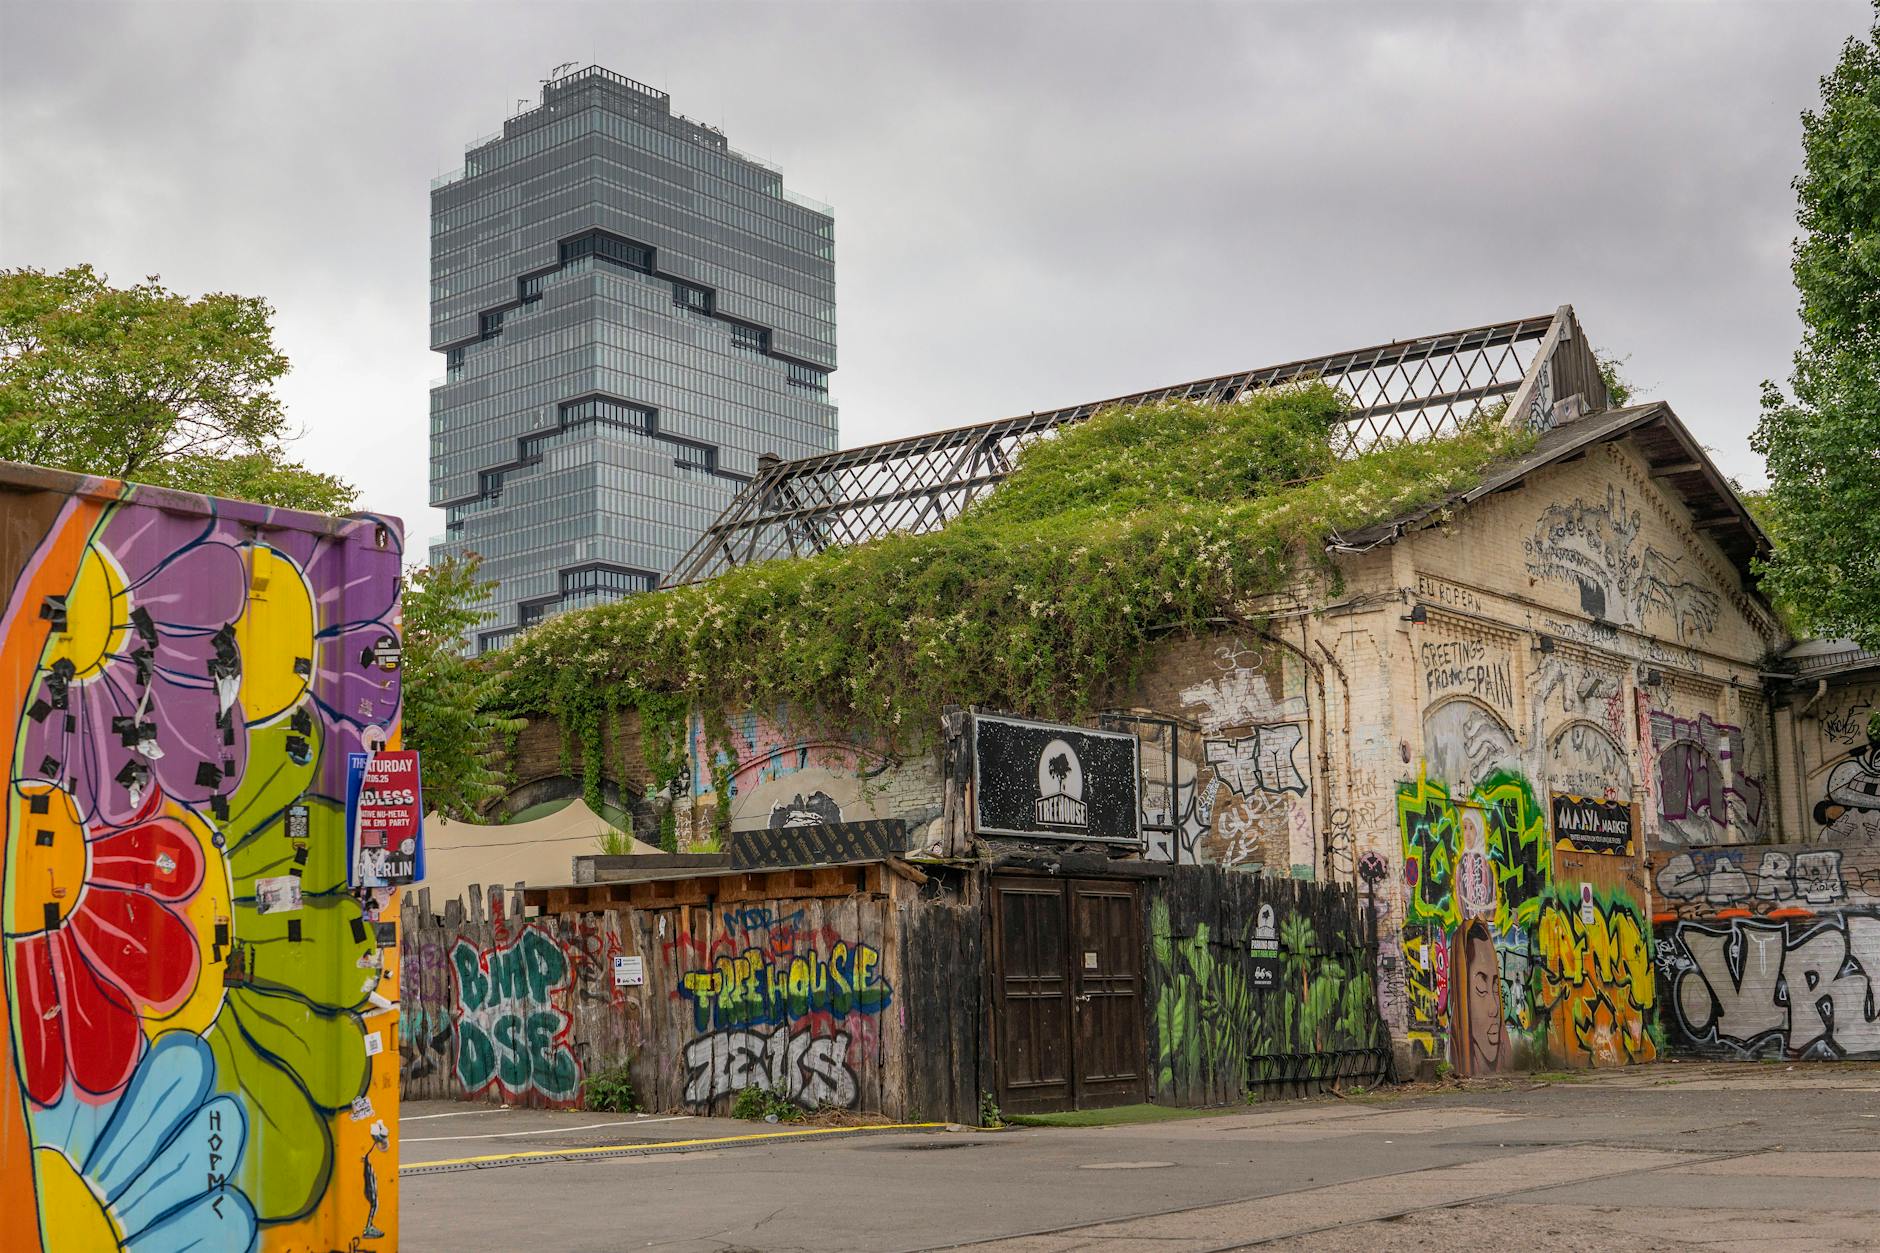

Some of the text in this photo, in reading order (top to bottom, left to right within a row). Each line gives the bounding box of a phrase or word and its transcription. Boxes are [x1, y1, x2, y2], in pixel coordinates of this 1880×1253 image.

[1421, 639, 1486, 669] GREETINGS
[1466, 658, 1513, 710] SPAIN
[365, 759, 413, 772] ATURDAY
[360, 789, 414, 806] ADLESS
[1037, 794, 1086, 825] TREEHOUSE
[389, 819, 410, 827] PARTY
[1558, 806, 1629, 835] MAAYA MARKET
[368, 861, 412, 878] BERLIN
[451, 928, 568, 1011] BMP
[679, 941, 892, 1031] TREEHOUSE
[456, 1011, 582, 1098] DSE
